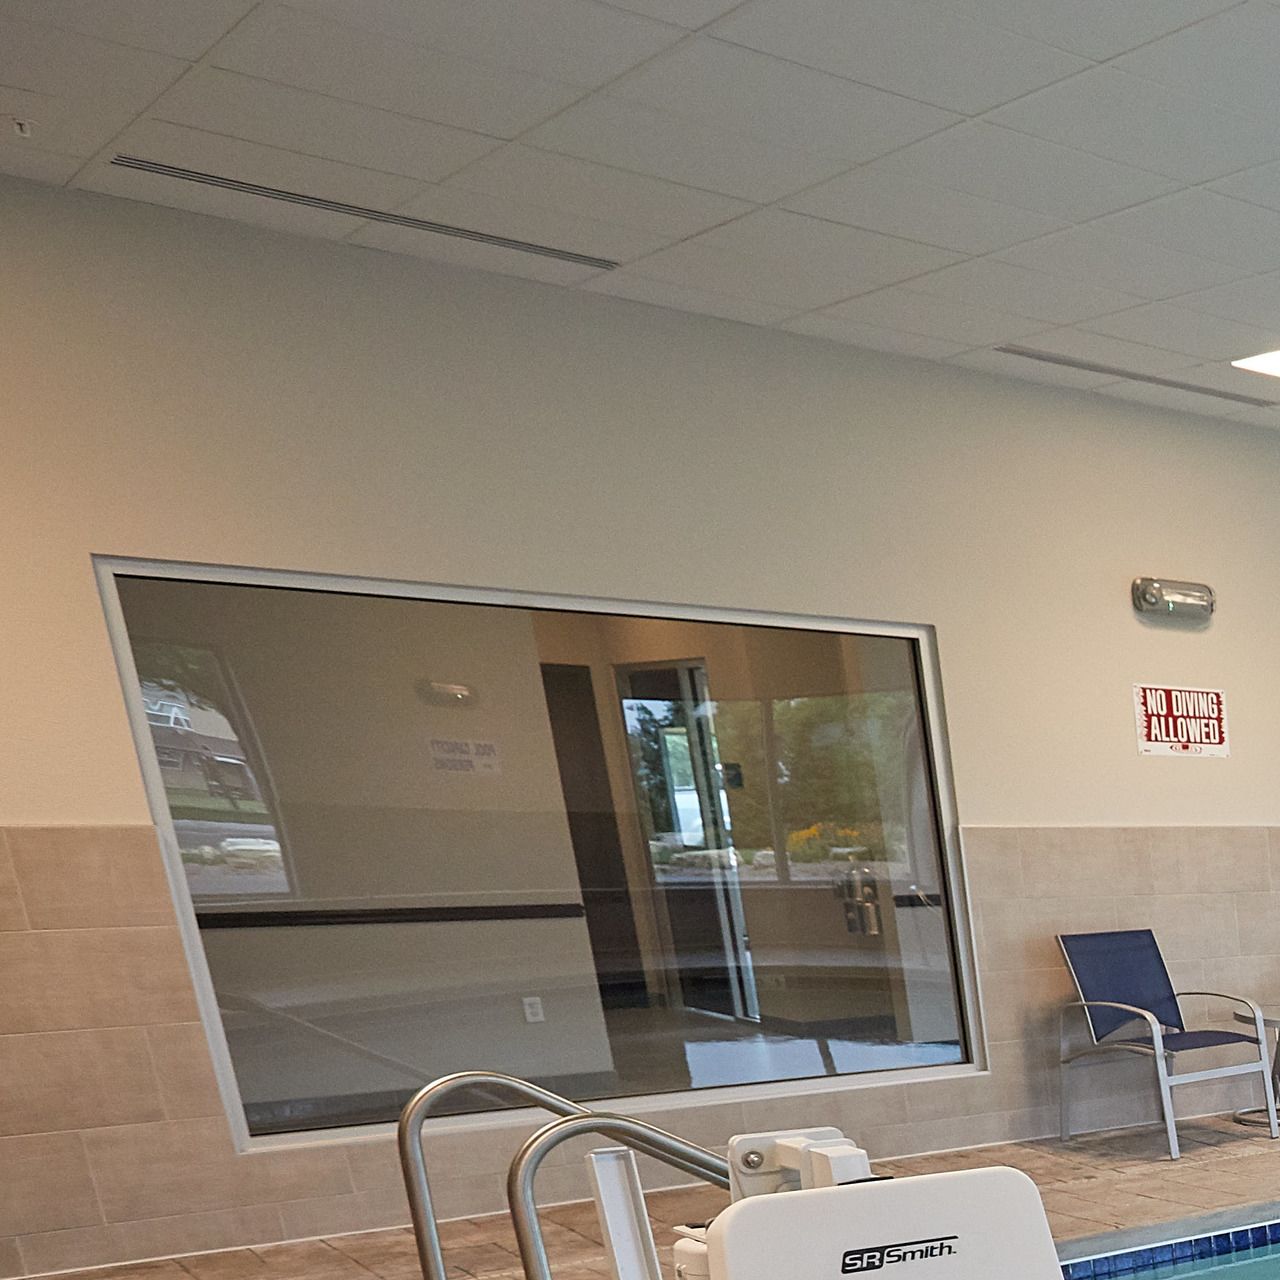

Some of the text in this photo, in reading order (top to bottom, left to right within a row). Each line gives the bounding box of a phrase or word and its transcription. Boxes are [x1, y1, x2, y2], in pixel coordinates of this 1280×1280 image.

[1145, 689, 1218, 718] NO DIVING
[1150, 717, 1220, 744] ALLOWED
